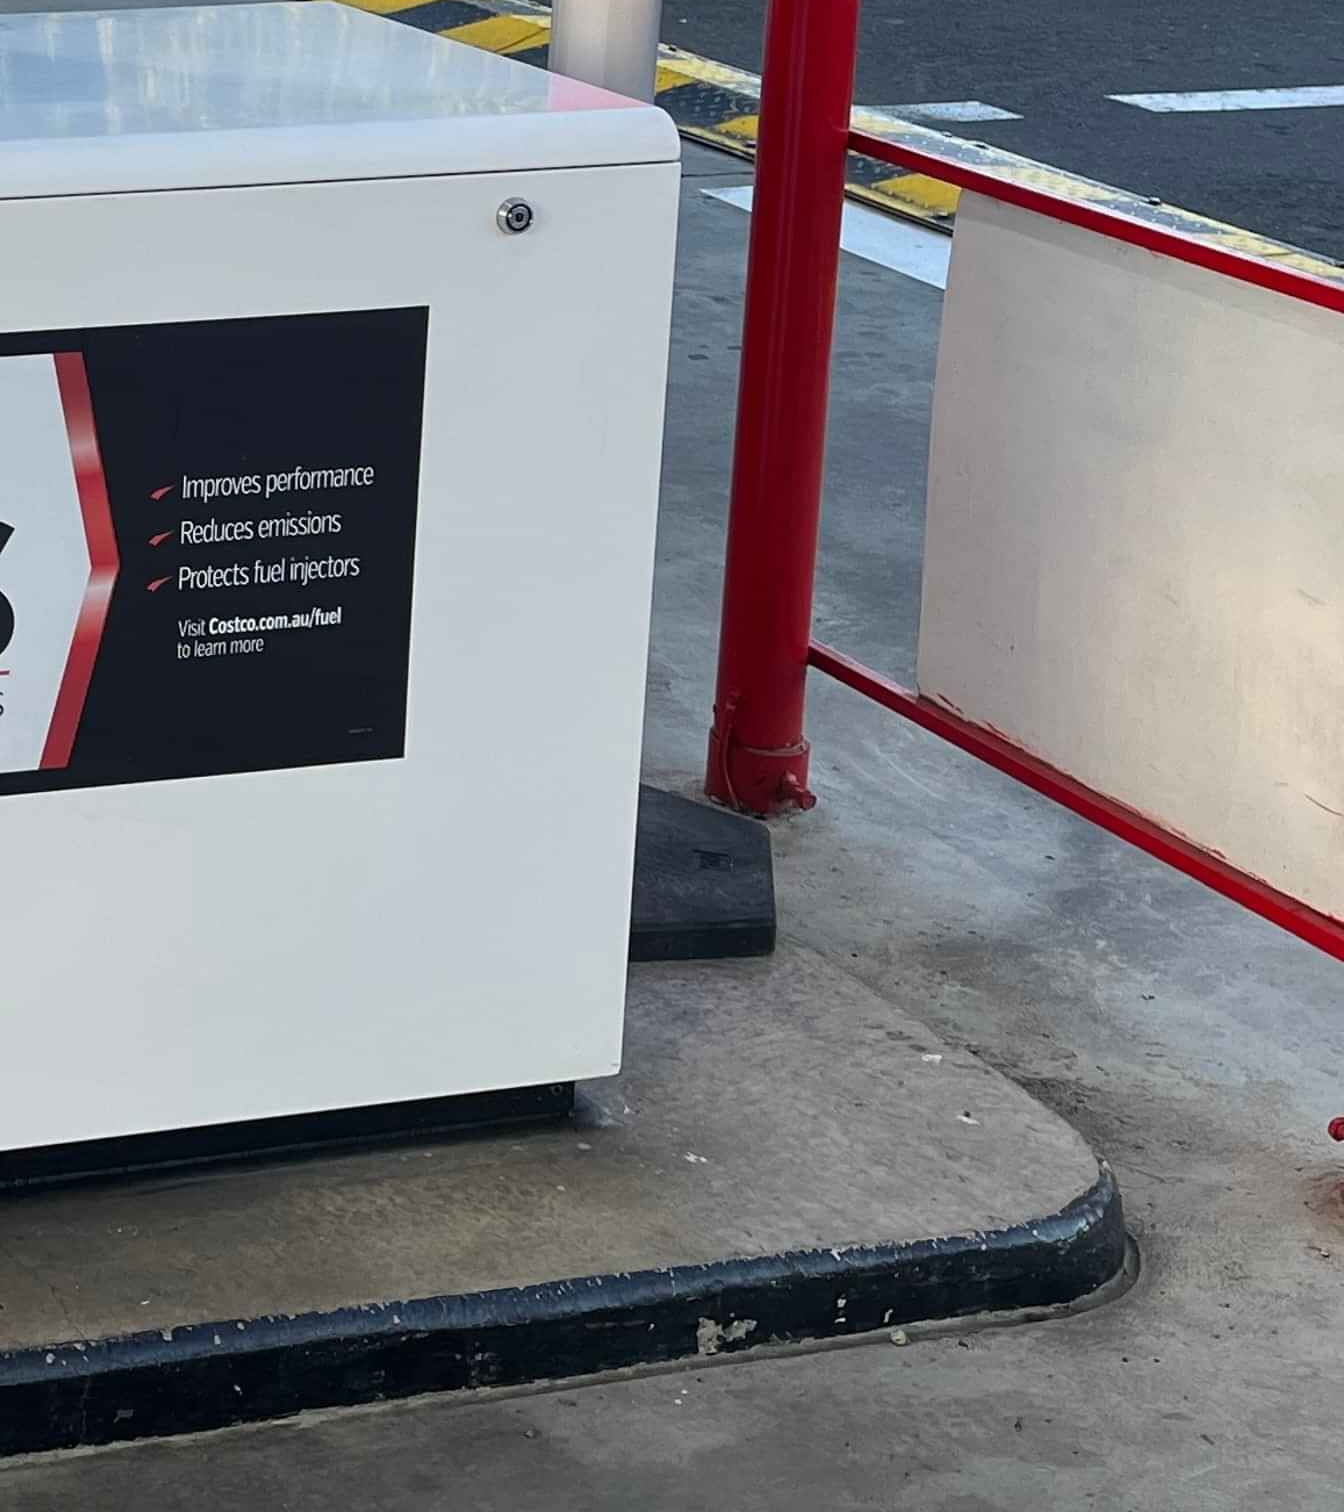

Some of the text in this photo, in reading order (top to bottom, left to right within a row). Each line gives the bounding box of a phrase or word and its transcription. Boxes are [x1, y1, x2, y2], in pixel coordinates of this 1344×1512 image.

[182, 465, 375, 503] Improves performance
[180, 510, 342, 544] Reduces emissions
[178, 555, 361, 591] Protects fuel injectors
[178, 607, 342, 637] Visit Costco.com.au/fuel
[177, 638, 264, 659] to learn more
